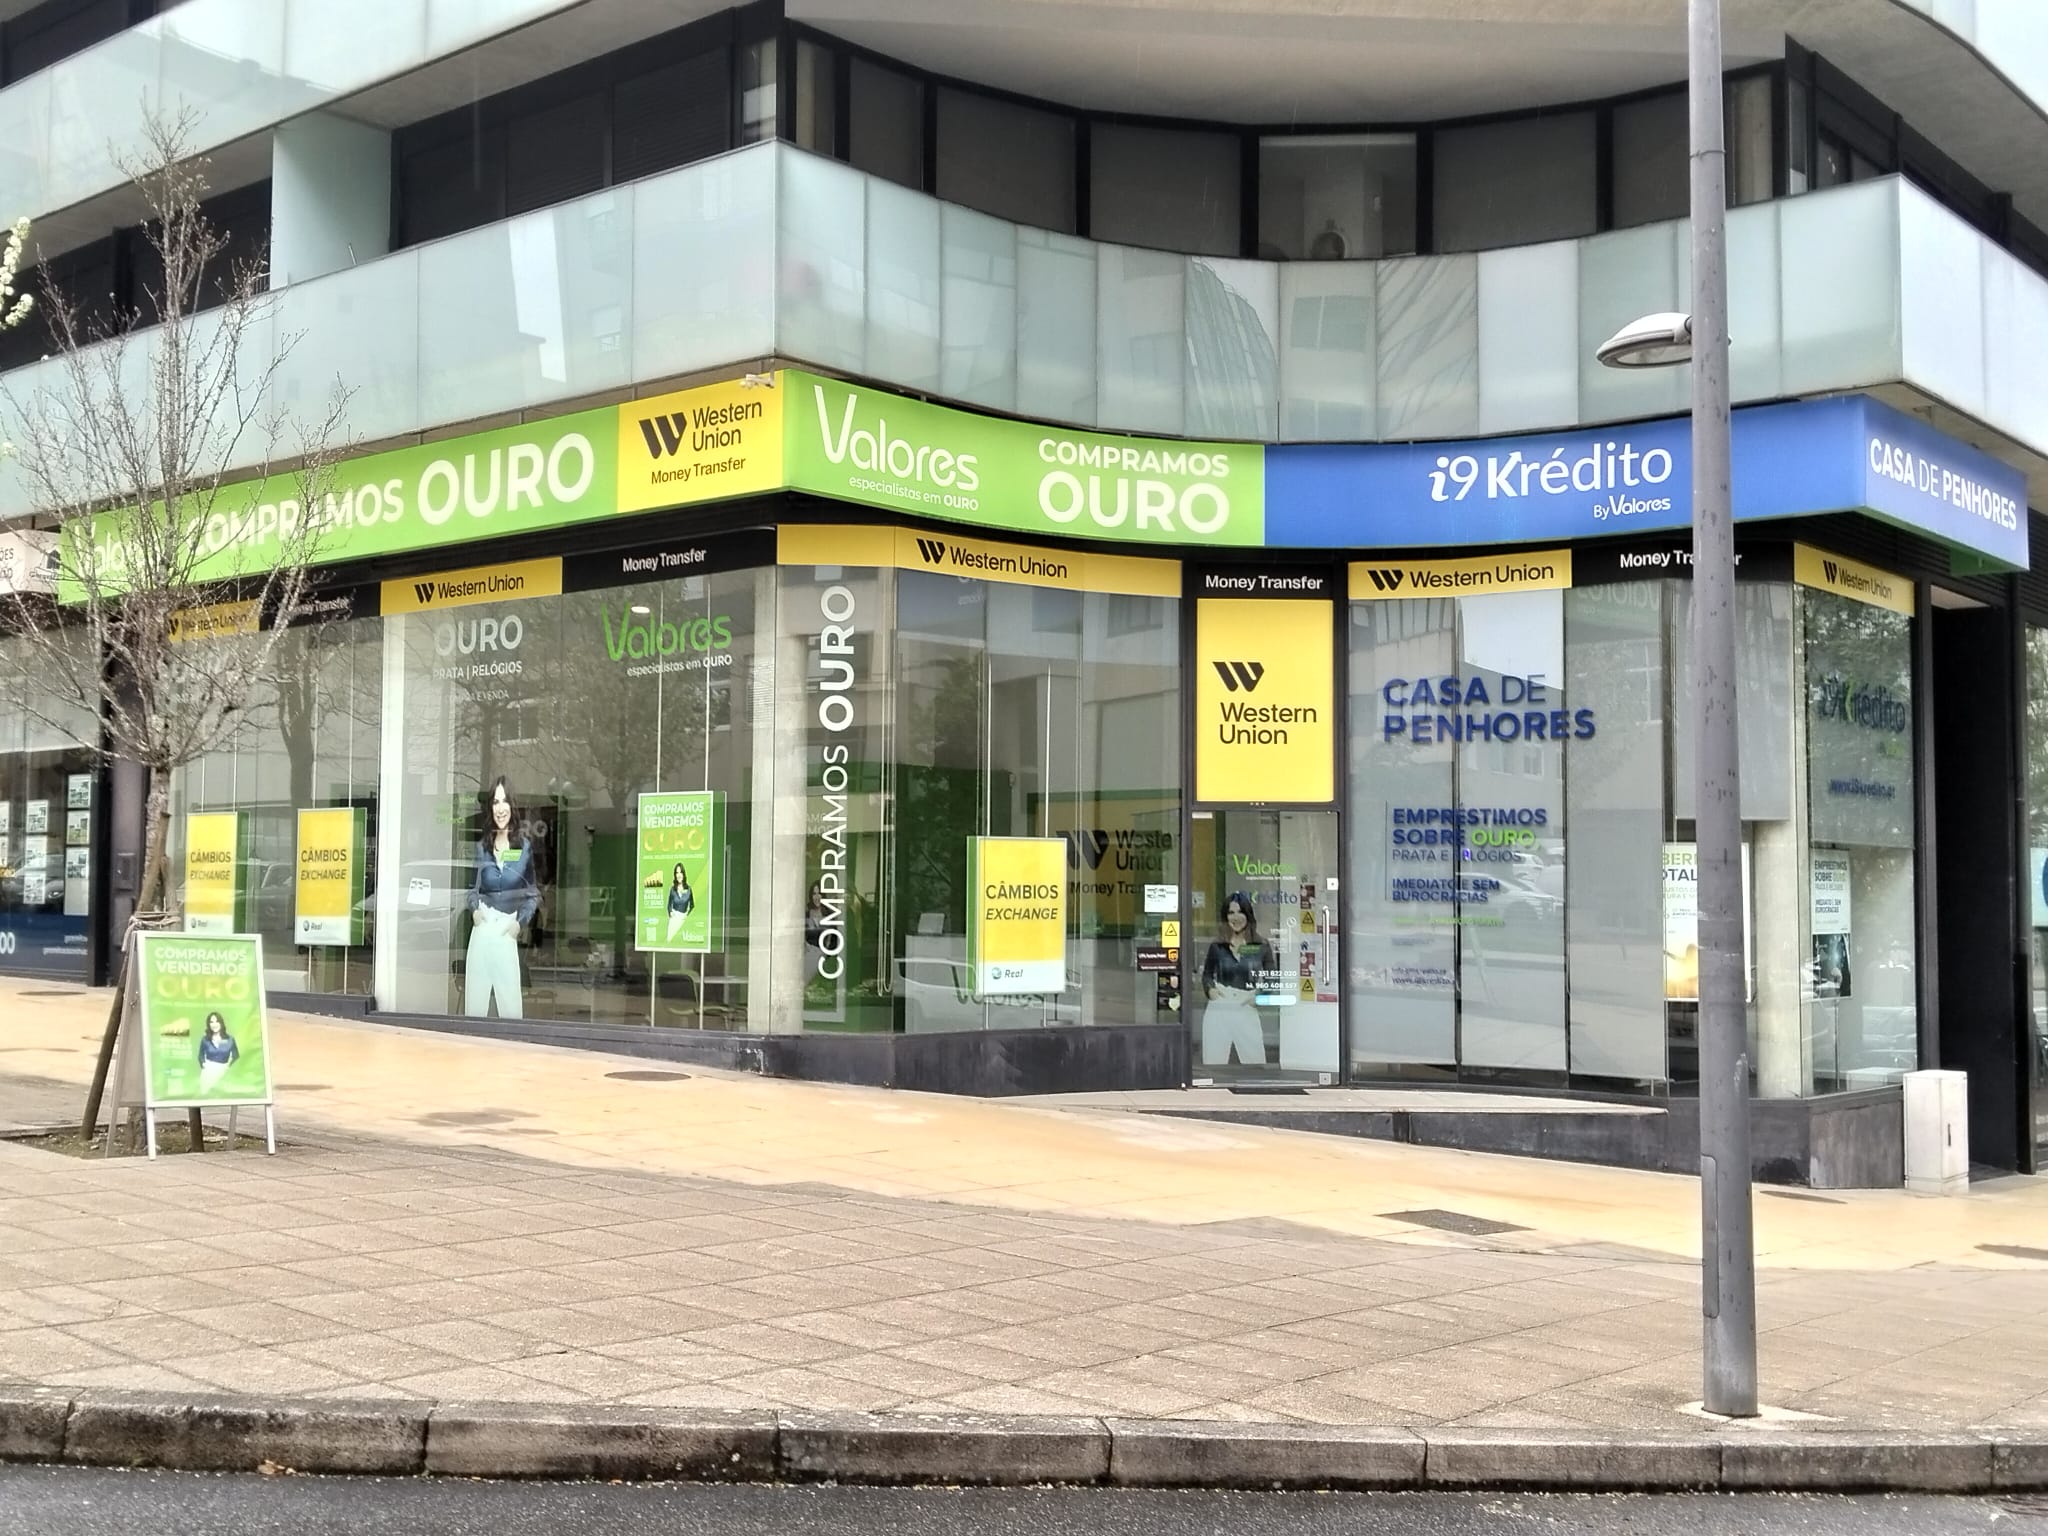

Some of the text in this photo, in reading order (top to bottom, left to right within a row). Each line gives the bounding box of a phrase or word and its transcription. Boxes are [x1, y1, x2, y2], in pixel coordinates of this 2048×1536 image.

[692, 401, 762, 429] Western
[693, 427, 741, 451] Union
[814, 384, 979, 491] Valores
[1038, 438, 1230, 478] COMPRAMOS
[651, 457, 746, 485] Money Transfer
[1428, 441, 1673, 501] i9 Krédito
[187, 478, 404, 555] COMPRAMOS
[418, 433, 594, 525] OURO
[849, 476, 979, 511] especialistas em OURO
[1870, 438, 2017, 531] CASA DE PENHORES
[1038, 470, 1230, 534] OURO
[1593, 494, 1671, 520] By Valores
[622, 548, 707, 572] Money Transfer
[950, 546, 1016, 572] Western
[1019, 555, 1067, 578] Union
[1620, 551, 1670, 568] Money
[438, 580, 486, 599] Western
[488, 574, 524, 592] Union
[1205, 575, 1323, 591] Money Transfer
[1409, 567, 1492, 589] Western
[1496, 563, 1554, 583] Union
[1838, 567, 1870, 591] Western
[1870, 578, 1892, 600] Union
[434, 614, 523, 656] OURO
[601, 599, 732, 661] Valores
[472, 661, 522, 677] RELÓGIOS
[626, 654, 732, 677] especialistas em OURO
[819, 585, 855, 732] OURO
[1383, 674, 1546, 706] CASA DE
[1220, 702, 1317, 723] Western
[1219, 724, 1288, 744] Union
[1383, 709, 1596, 743] PENHORES
[644, 802, 704, 815] COMPRAMOS
[644, 815, 704, 829] VENDEMOS
[1393, 829, 1466, 846] SOBRE
[190, 848, 232, 864] CÂMBIOS
[301, 847, 347, 863] CÂMBIOS
[818, 744, 849, 979] COMPRAMOS
[1392, 850, 1437, 862] PRATA
[1441, 850, 1449, 861] E
[190, 868, 231, 881] EXCHANGE
[300, 868, 347, 881] EXCHANGE
[1393, 879, 1456, 890] IMEDIATO
[1473, 879, 1500, 890] SEM
[985, 880, 1059, 899] CÂMBIOS
[985, 907, 1059, 920] EXCHANGE
[154, 946, 248, 961] COMPRAMOS
[156, 960, 249, 975] VENDEMOS
[1004, 969, 1024, 978] Real
[157, 976, 250, 1001] OURO
